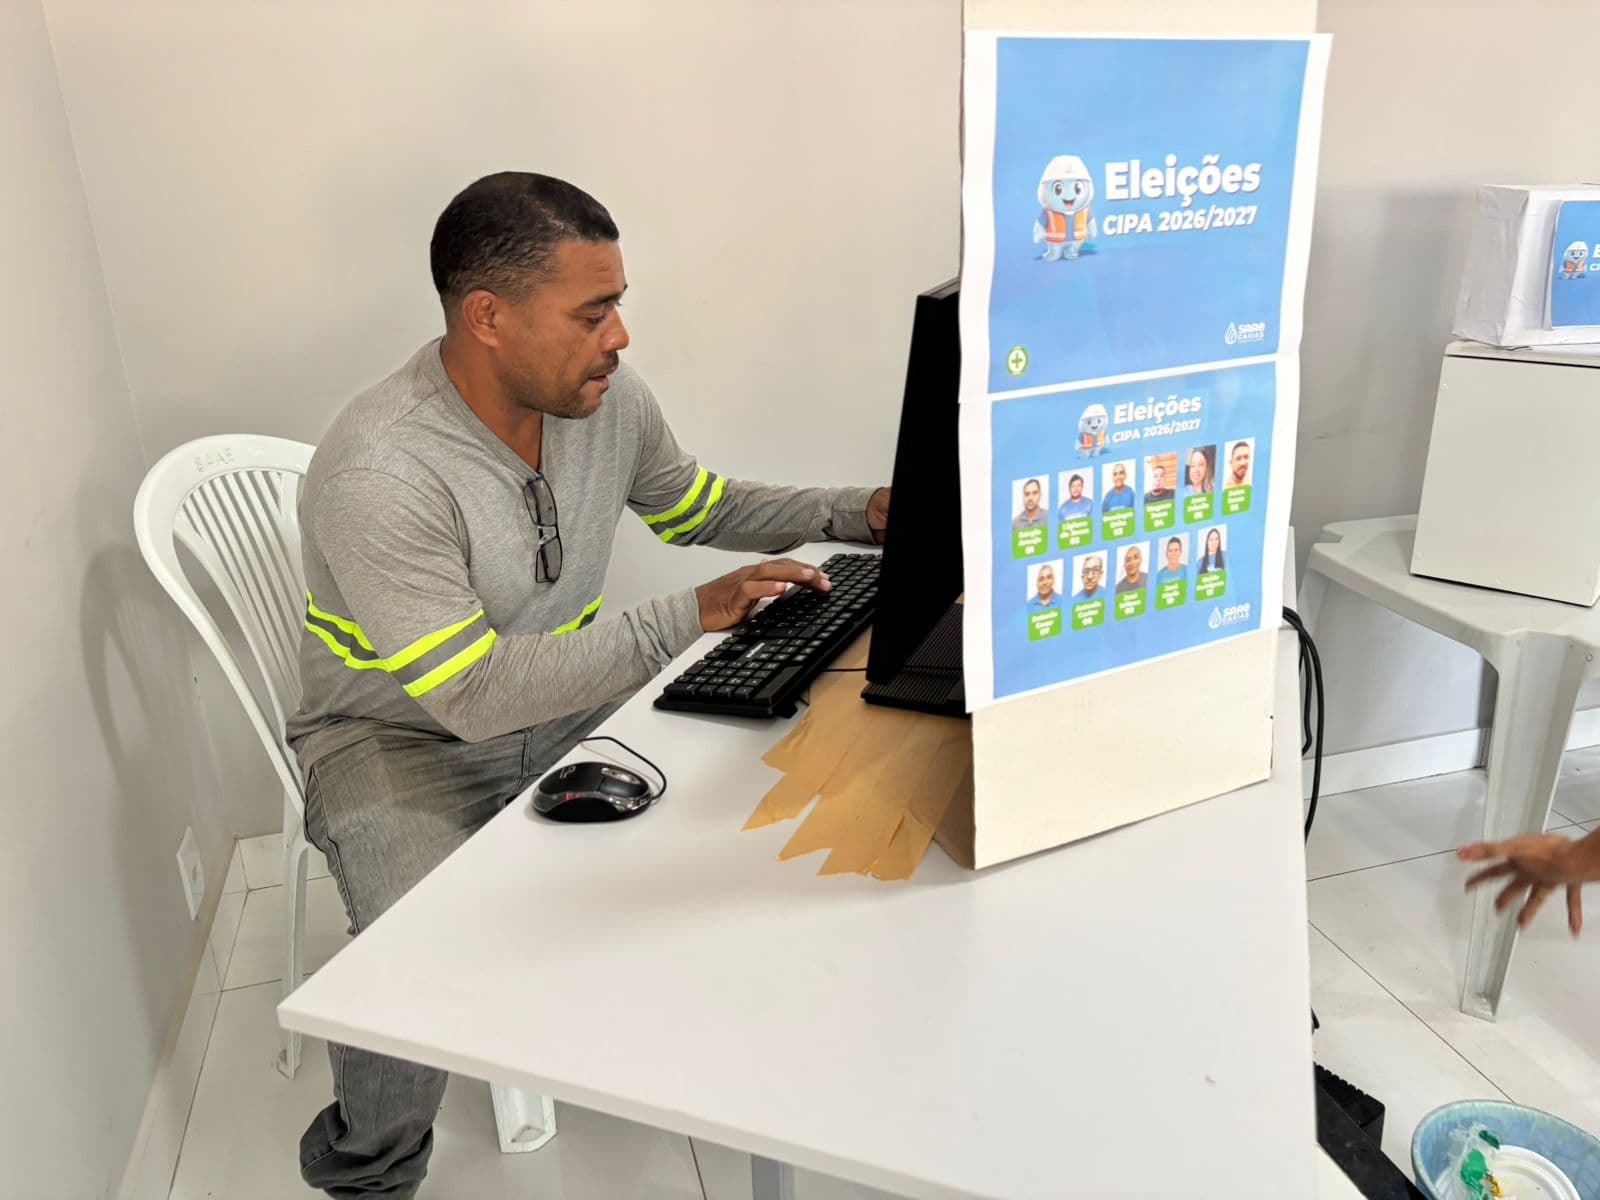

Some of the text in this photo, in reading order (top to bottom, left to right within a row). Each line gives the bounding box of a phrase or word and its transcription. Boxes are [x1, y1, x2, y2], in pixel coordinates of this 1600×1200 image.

[1104, 153, 1262, 207] Eleições
[1103, 205, 1258, 236] CIPA 2026/2027
[1113, 394, 1202, 424] Eleições
[1112, 418, 1201, 444] CIPA 2026/2027
